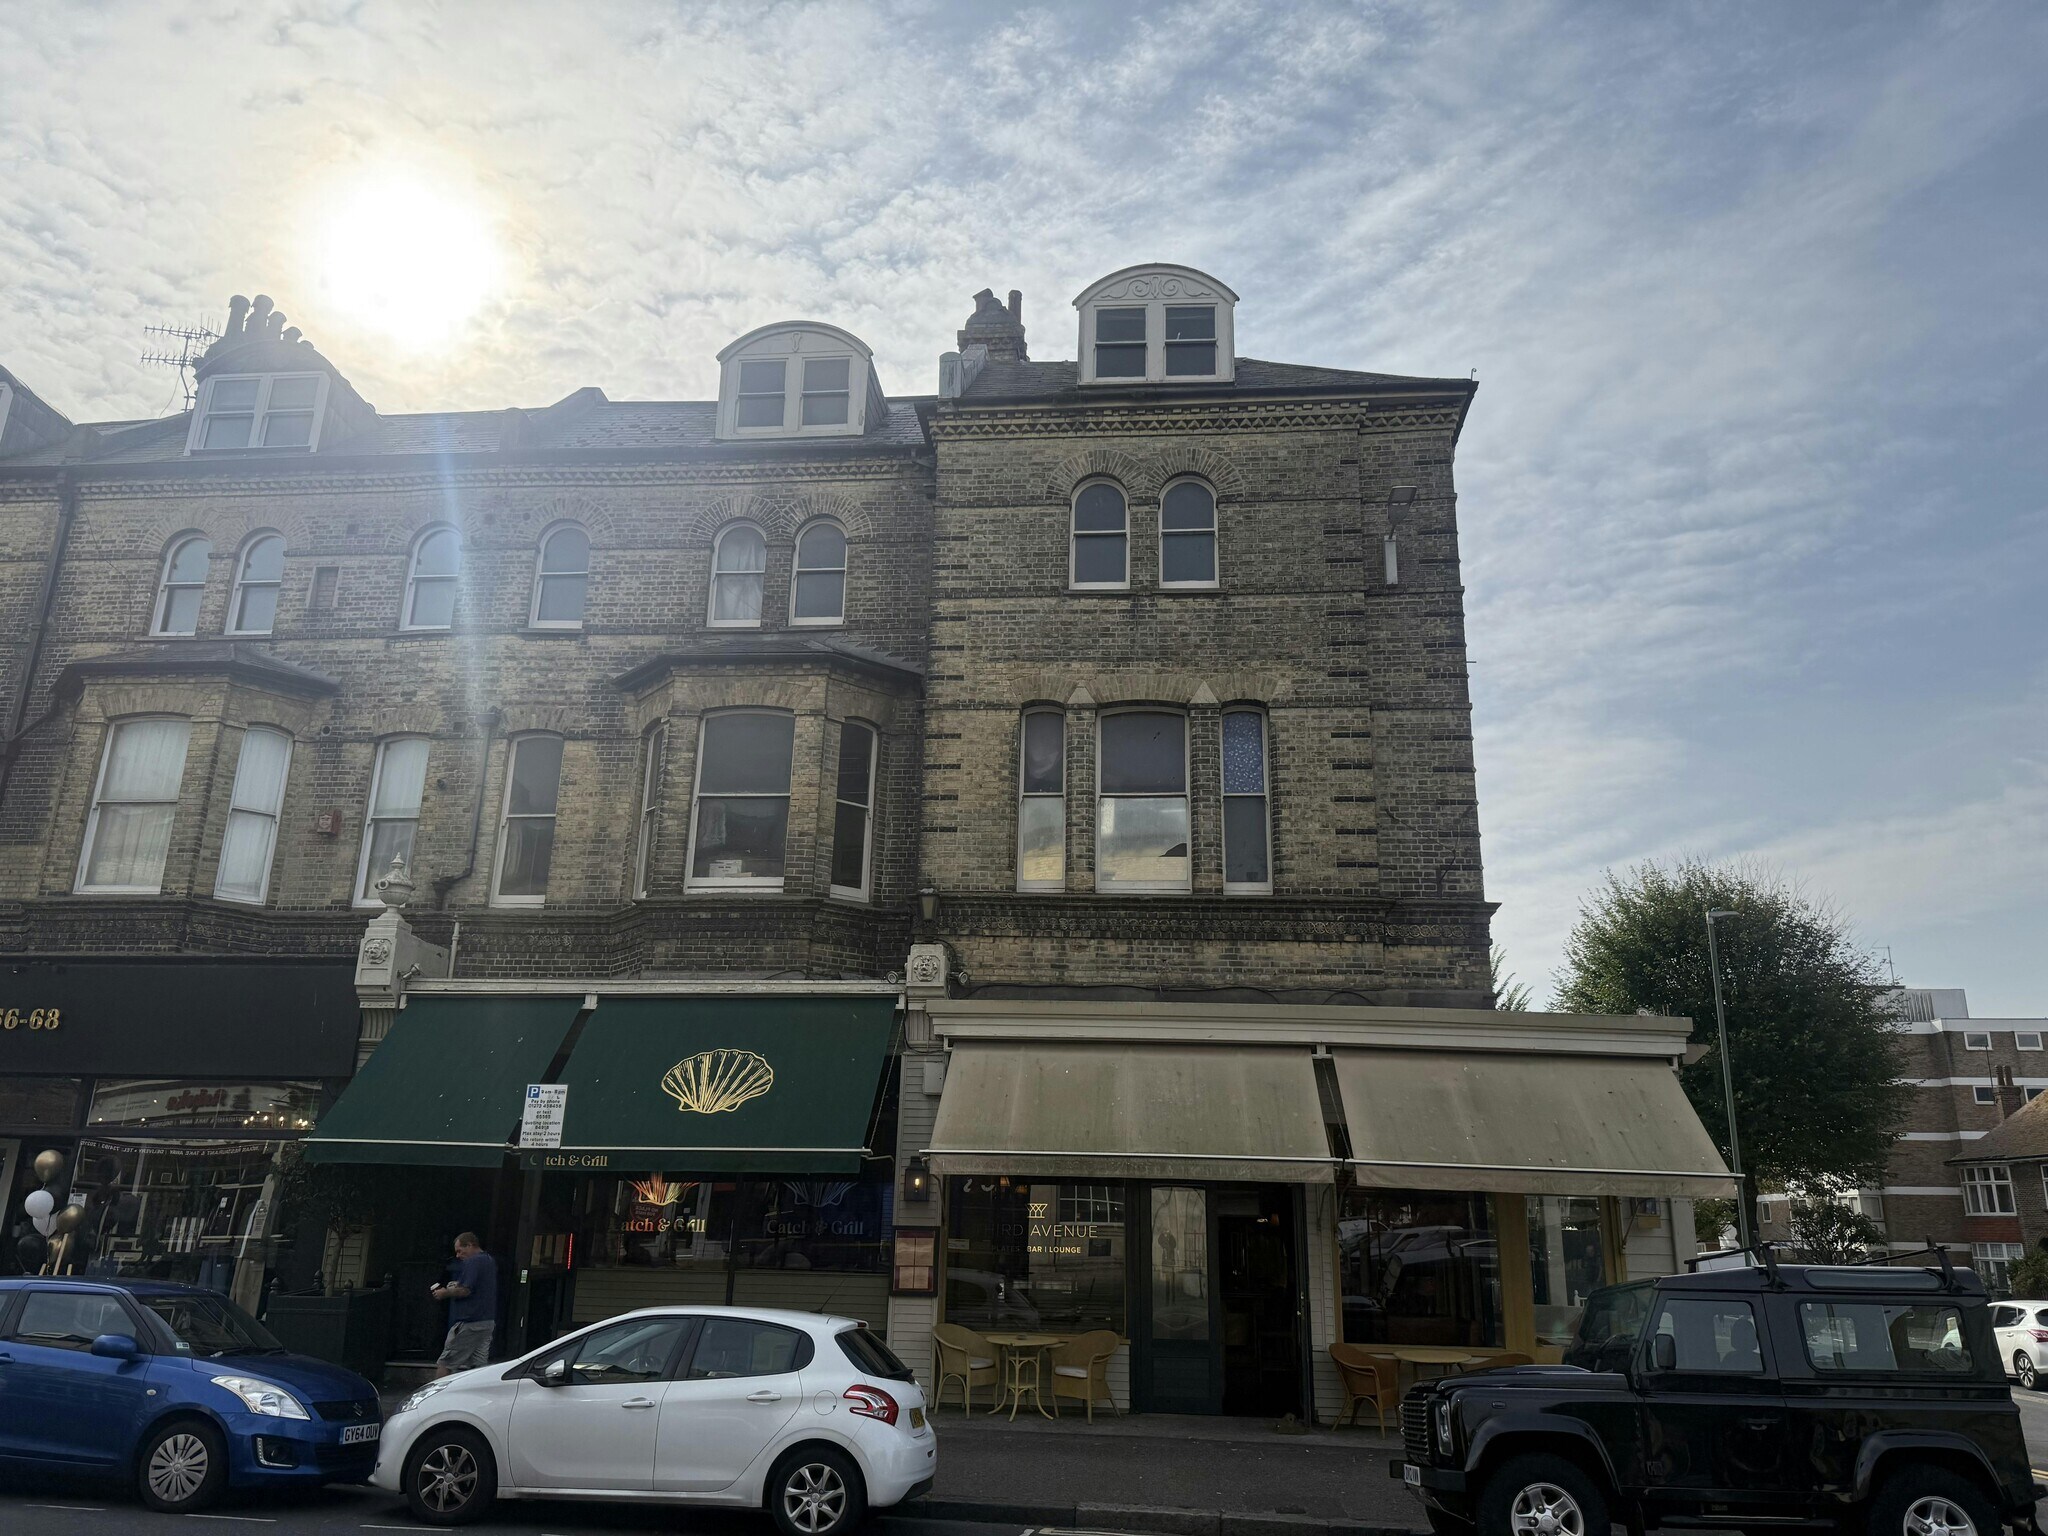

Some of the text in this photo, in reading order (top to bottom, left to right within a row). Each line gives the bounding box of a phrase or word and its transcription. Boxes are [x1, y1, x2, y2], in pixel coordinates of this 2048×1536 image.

[0, 1008, 61, 1030] 6-68
[530, 1153, 608, 1166] Ctch & Grill
[657, 1218, 671, 1232] &
[673, 1218, 706, 1233] Grill
[831, 1220, 865, 1235] Grill
[979, 1223, 1099, 1238] HIRD AVENUE
[1026, 1245, 1043, 1253] BAR
[1048, 1246, 1081, 1254] LOUNGE
[344, 1426, 365, 1441] GY64
